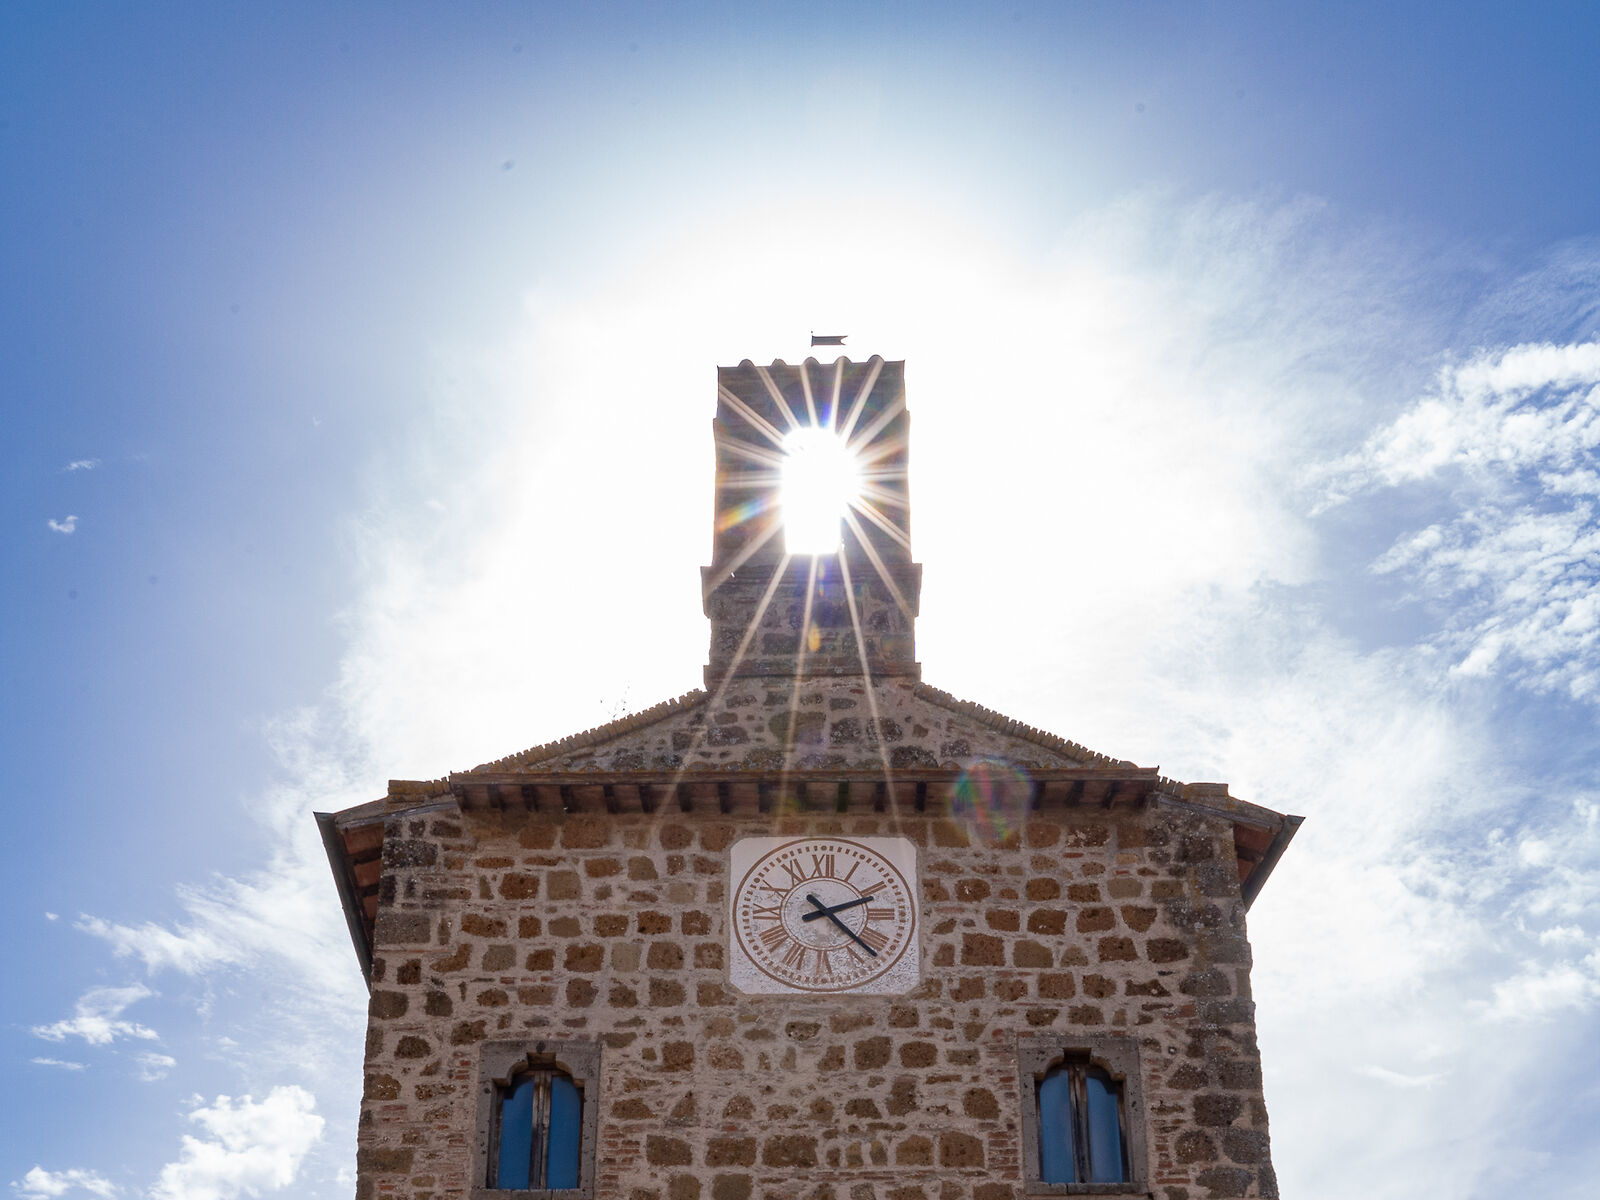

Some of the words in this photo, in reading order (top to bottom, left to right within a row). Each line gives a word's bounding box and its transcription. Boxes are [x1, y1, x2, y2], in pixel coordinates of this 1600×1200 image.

[780, 858, 807, 887] XI
[811, 854, 835, 878] XII
[759, 879, 791, 899] X
[860, 880, 888, 898] II
[753, 903, 781, 920] IX
[866, 908, 895, 921] III
